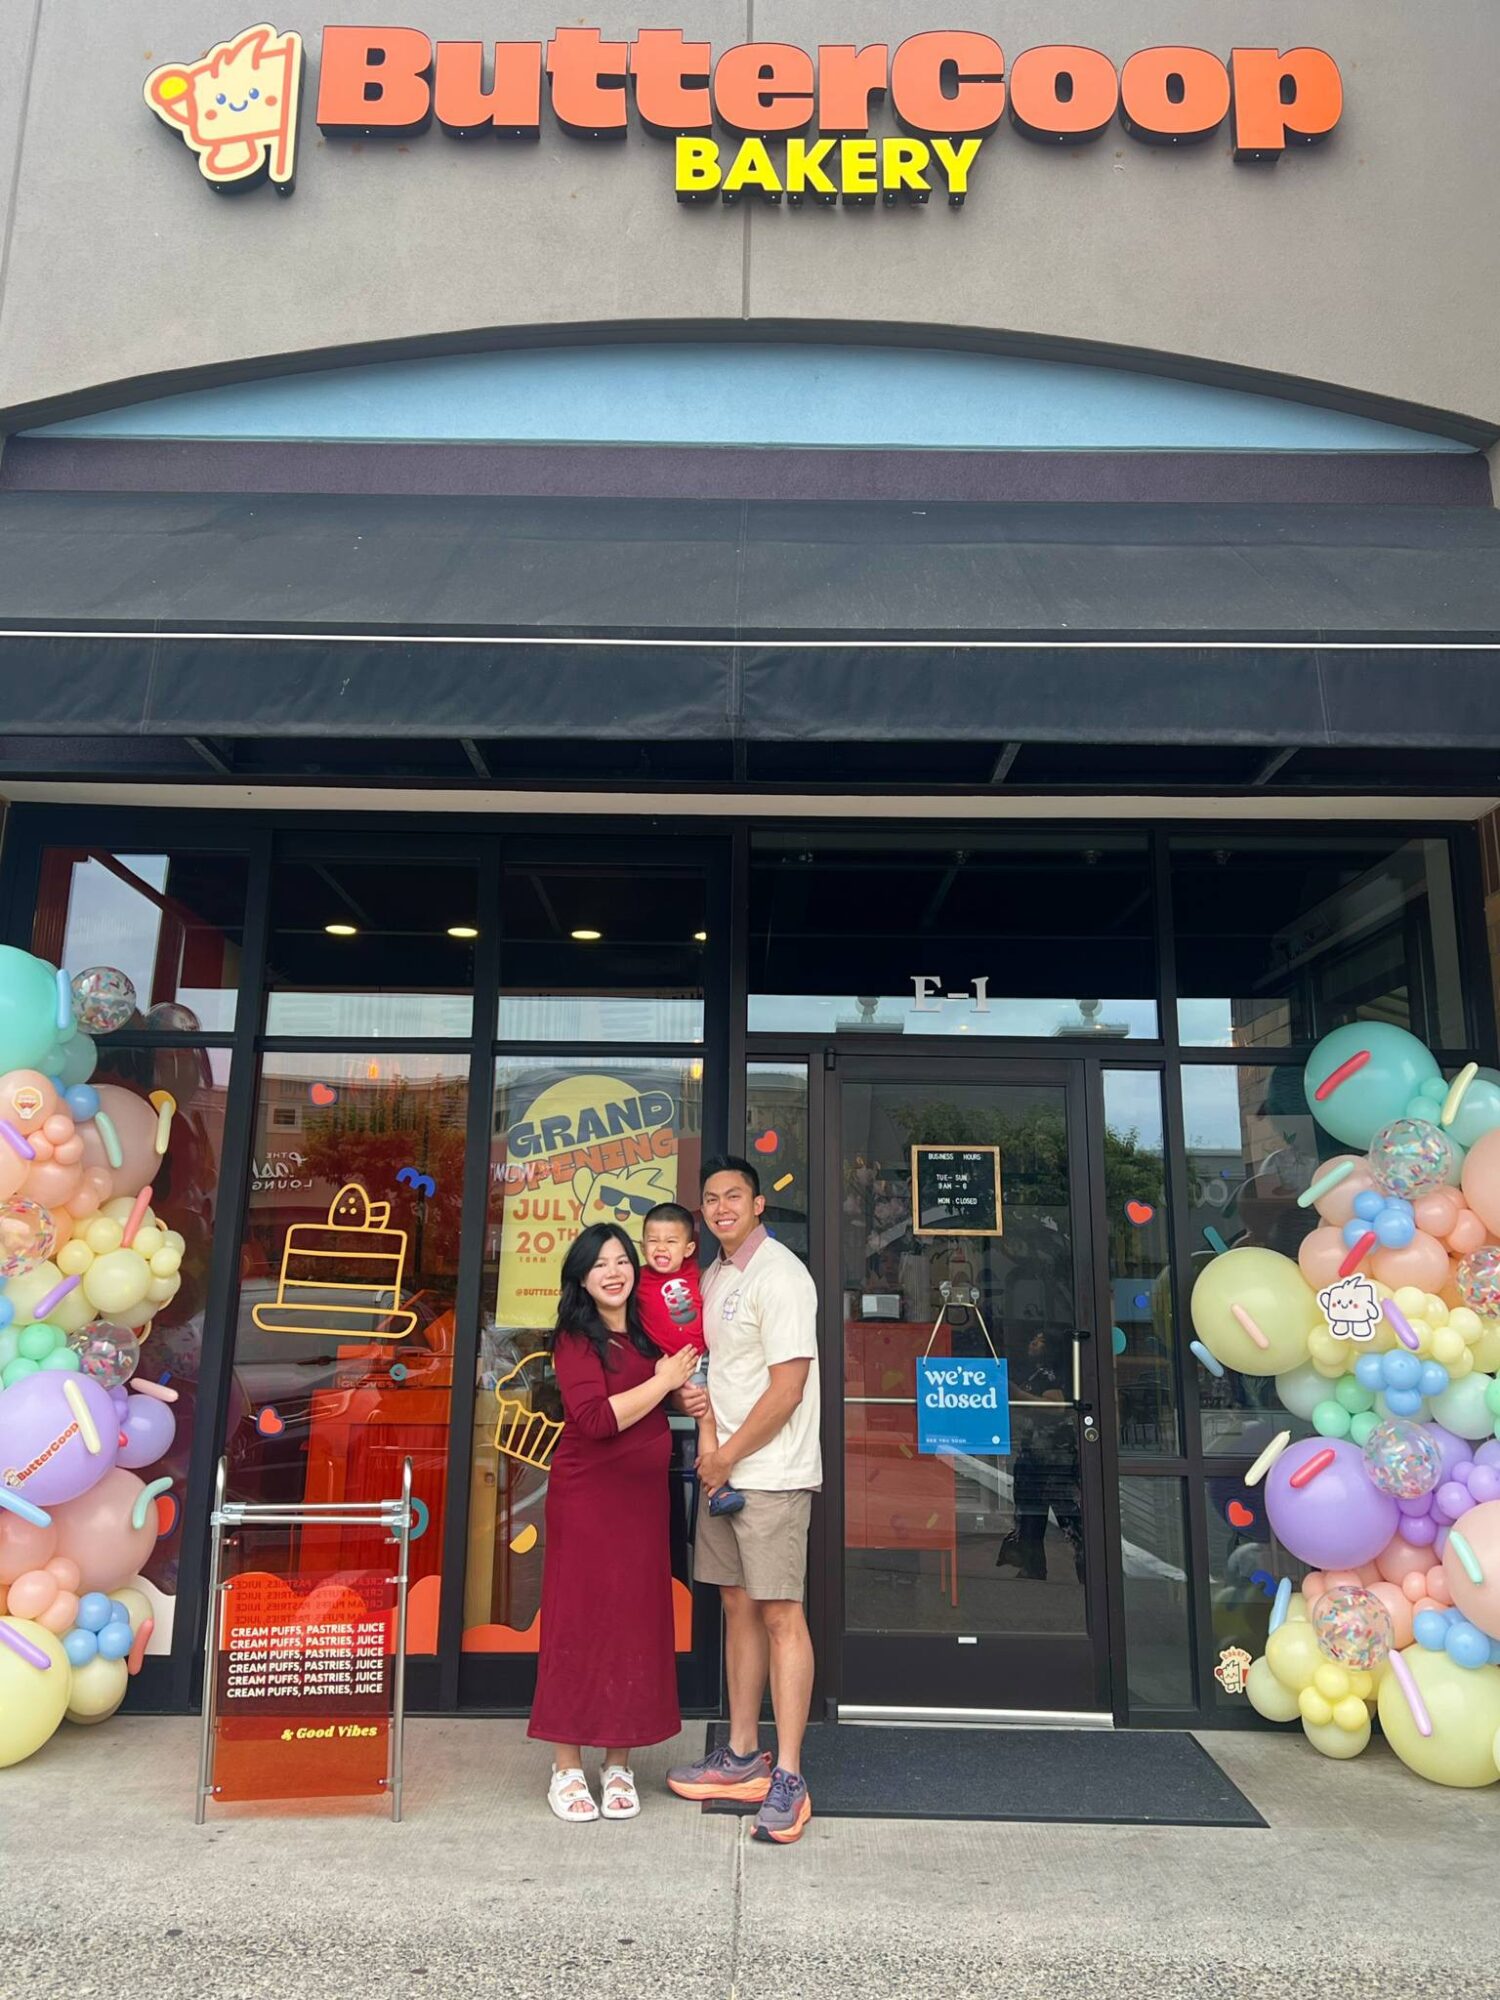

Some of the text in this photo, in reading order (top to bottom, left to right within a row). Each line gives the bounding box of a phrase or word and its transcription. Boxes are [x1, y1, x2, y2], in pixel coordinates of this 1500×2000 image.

[316, 25, 1343, 152] ButterCoop
[676, 137, 982, 193] BAKERY
[909, 976, 991, 1013] E-1
[507, 1091, 674, 1158] GRAND
[504, 1128, 678, 1196] OPENING
[513, 1199, 583, 1221] JULY
[955, 1197, 978, 1205] CLOSED
[924, 1366, 987, 1386] we're
[925, 1386, 998, 1409] closed
[231, 1623, 385, 1637] CREAM PUFFS, PASTRIES, JUICE
[230, 1635, 384, 1649] CREAM PUFFS, PASTRIES, JUICE
[229, 1647, 383, 1661] CREAM PUFFS, PASTRIES, JUICE
[229, 1660, 383, 1673] CREAM PUFFS, PASTRIES, JUICE
[228, 1671, 383, 1685] CREAM PUFFS, PASTRIES, JUICE
[227, 1683, 383, 1697] CREAM PUFFS, PASTRIES, JUICE
[281, 1724, 378, 1741] & Good Vibes
